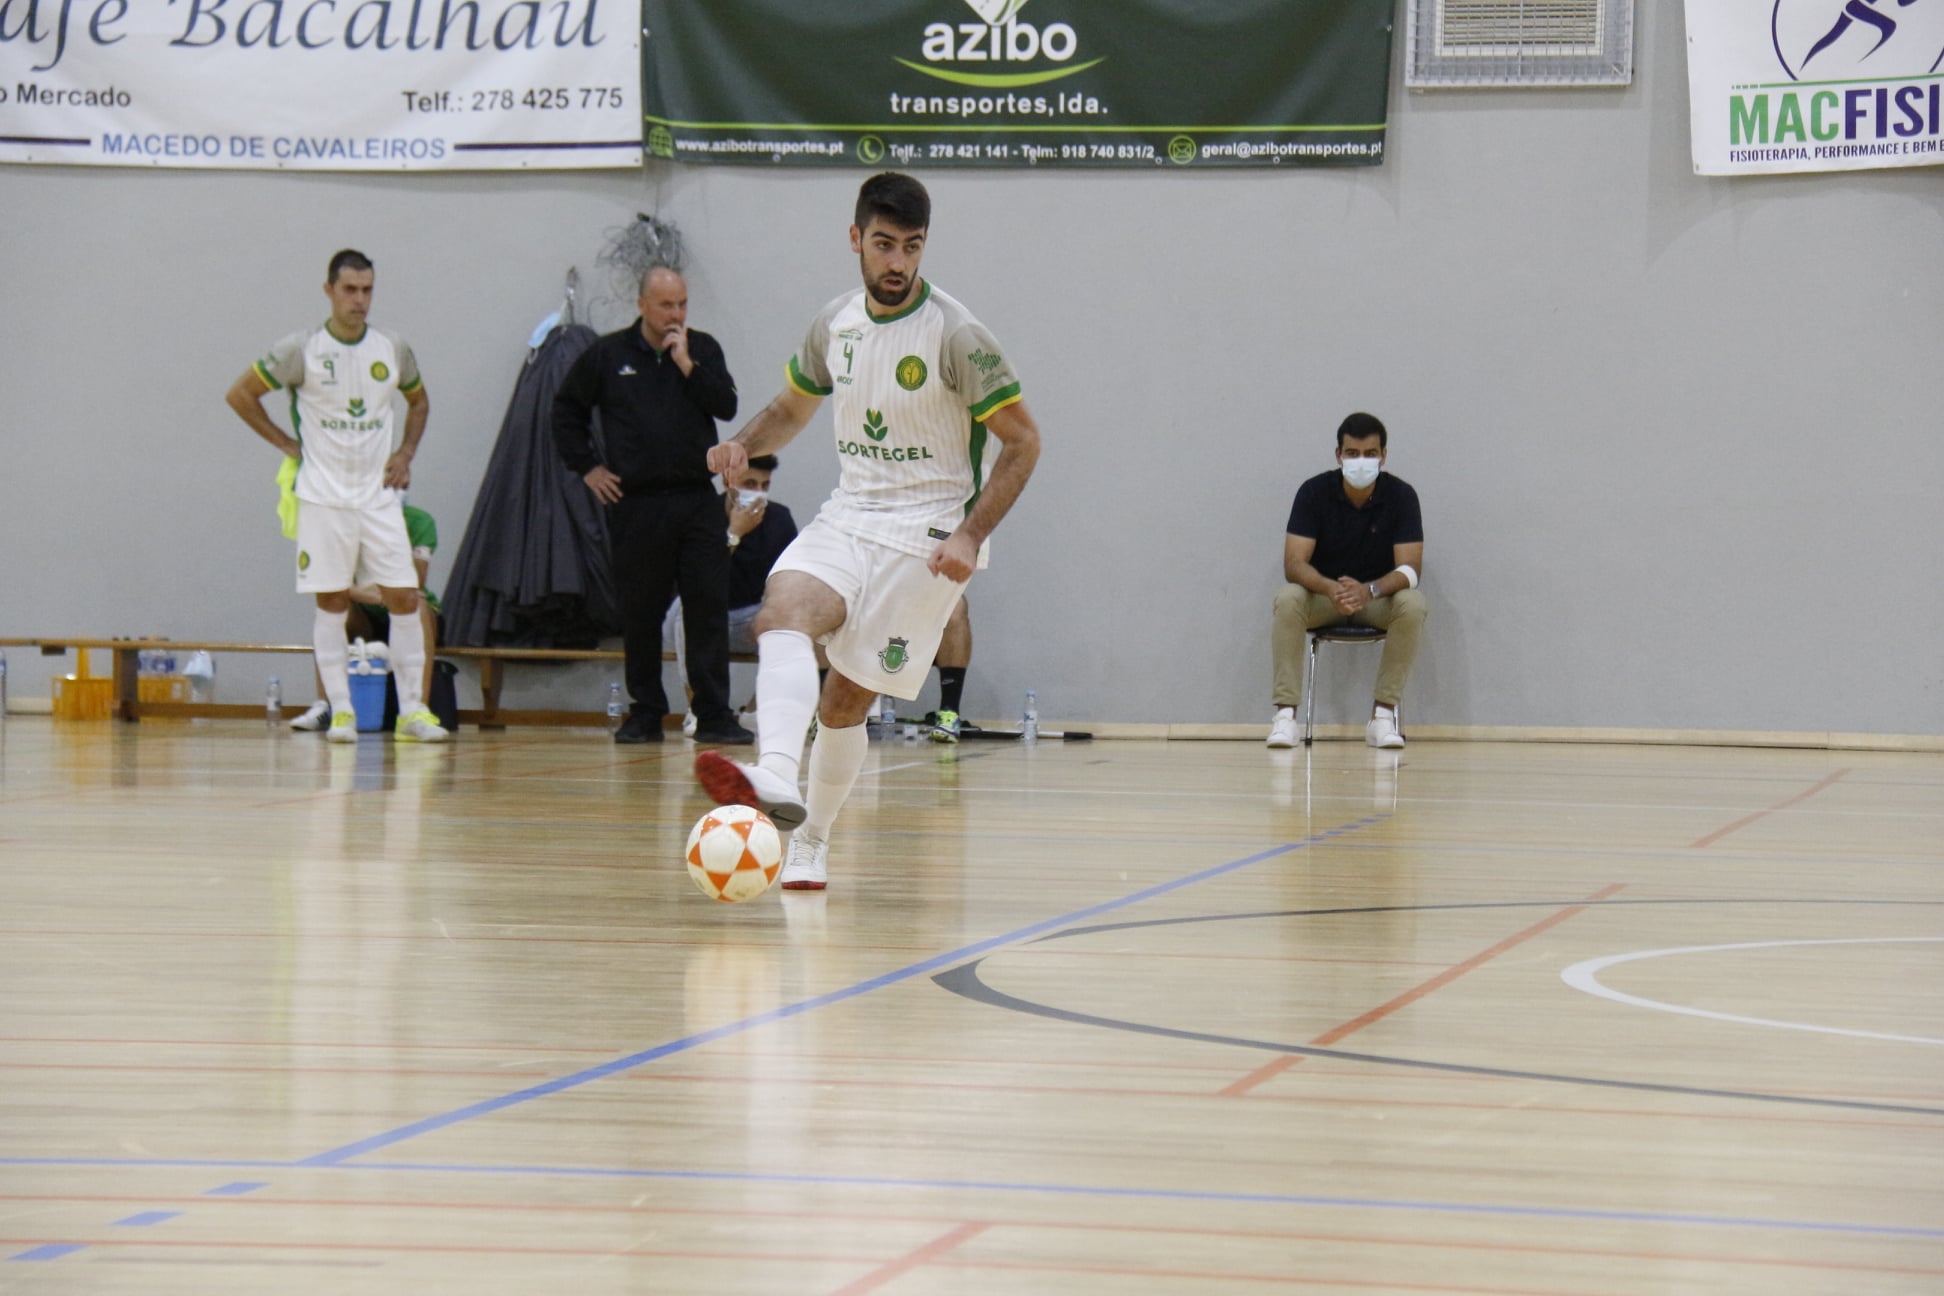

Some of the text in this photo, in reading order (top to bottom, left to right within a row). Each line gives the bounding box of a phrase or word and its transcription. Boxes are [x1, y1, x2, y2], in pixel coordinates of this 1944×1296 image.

[922, 14, 1077, 61] azibo
[17, 83, 131, 107] Mercado
[402, 88, 623, 112] Telf.: 278 425 775
[102, 133, 445, 159] MACEDO DE CAVALEIROS
[675, 140, 844, 155] www.azibotransportes.pt
[930, 145, 953, 158] 278
[957, 145, 980, 158] 421
[986, 145, 1008, 158] 141
[1062, 145, 1086, 158] 918
[1091, 145, 1114, 158] 740
[1118, 145, 1155, 159] 831/2
[1202, 141, 1382, 158] geral@azibotransportes.pt
[1730, 147, 1811, 162] FISIOTERAPIA,
[1814, 143, 1899, 158] PERFORMANCE
[1903, 142, 1909, 154] E
[1913, 140, 1936, 153] BEM
[323, 360, 335, 379] 9
[843, 341, 854, 375] 4
[838, 440, 933, 462] SORTEGEL
